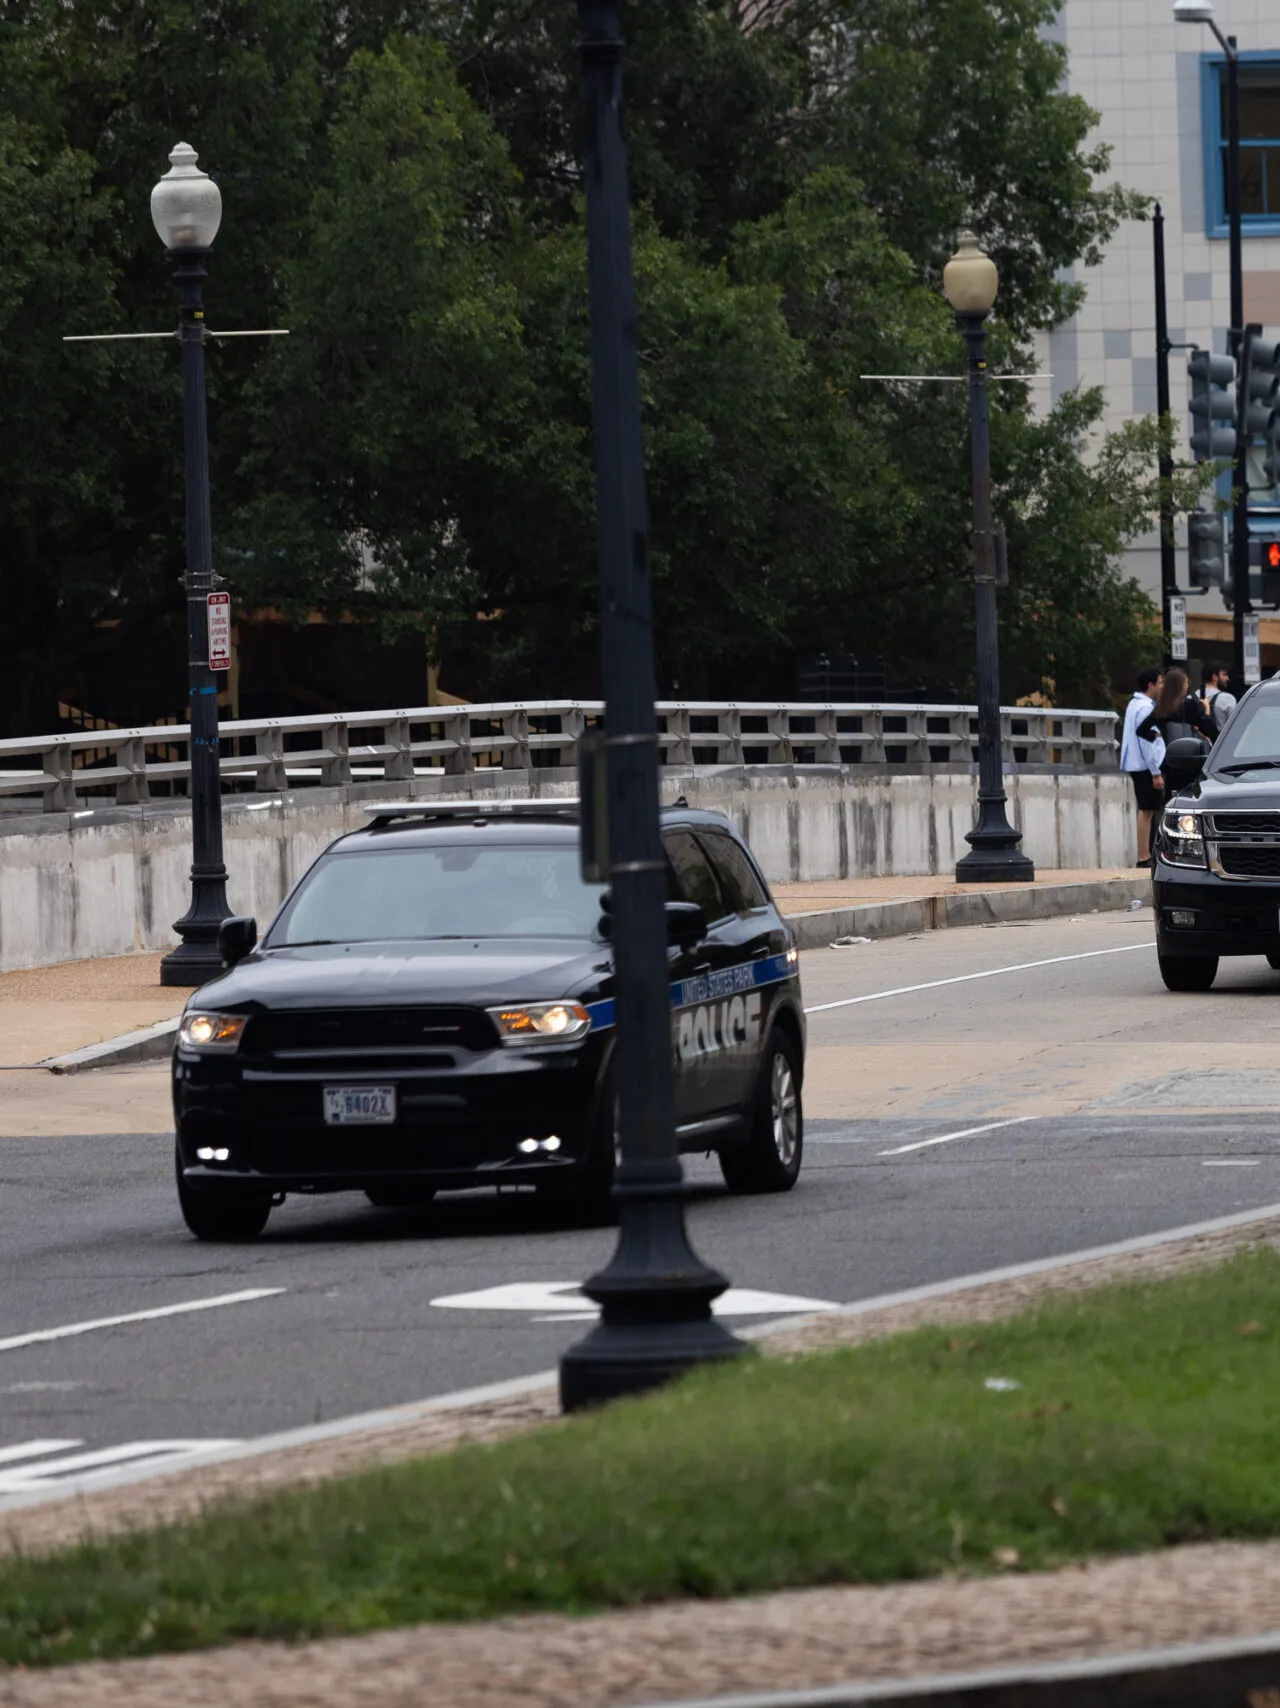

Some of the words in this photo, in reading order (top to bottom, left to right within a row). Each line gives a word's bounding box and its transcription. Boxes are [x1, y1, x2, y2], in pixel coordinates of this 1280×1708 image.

[682, 978, 708, 1003] UNITED
[708, 971, 733, 997] STATES
[734, 965, 755, 990] PARK
[678, 992, 761, 1059] POLICE
